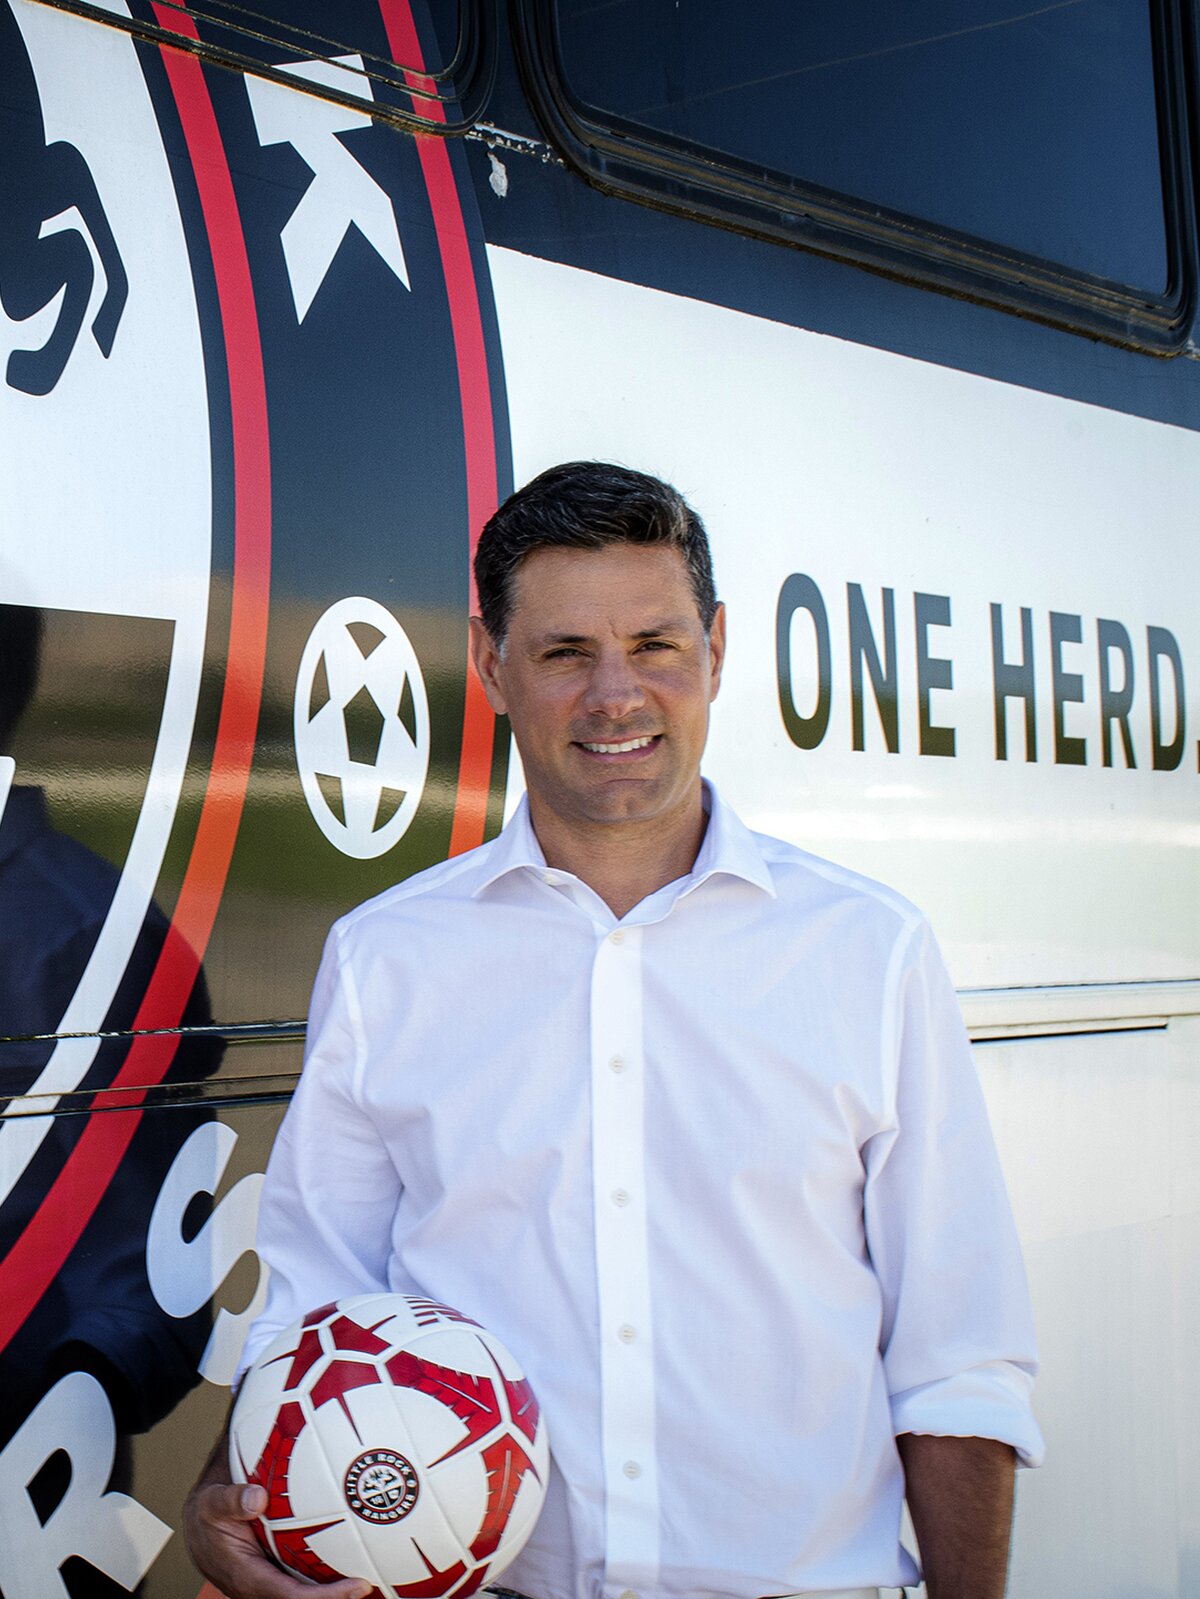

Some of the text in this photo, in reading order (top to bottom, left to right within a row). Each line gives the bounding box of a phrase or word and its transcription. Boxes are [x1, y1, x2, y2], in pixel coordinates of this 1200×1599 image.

[775, 572, 1200, 774] ONE HERD
[347, 1453, 412, 1496] LITTLE ROCK
[362, 1494, 416, 1520] RANGERS
